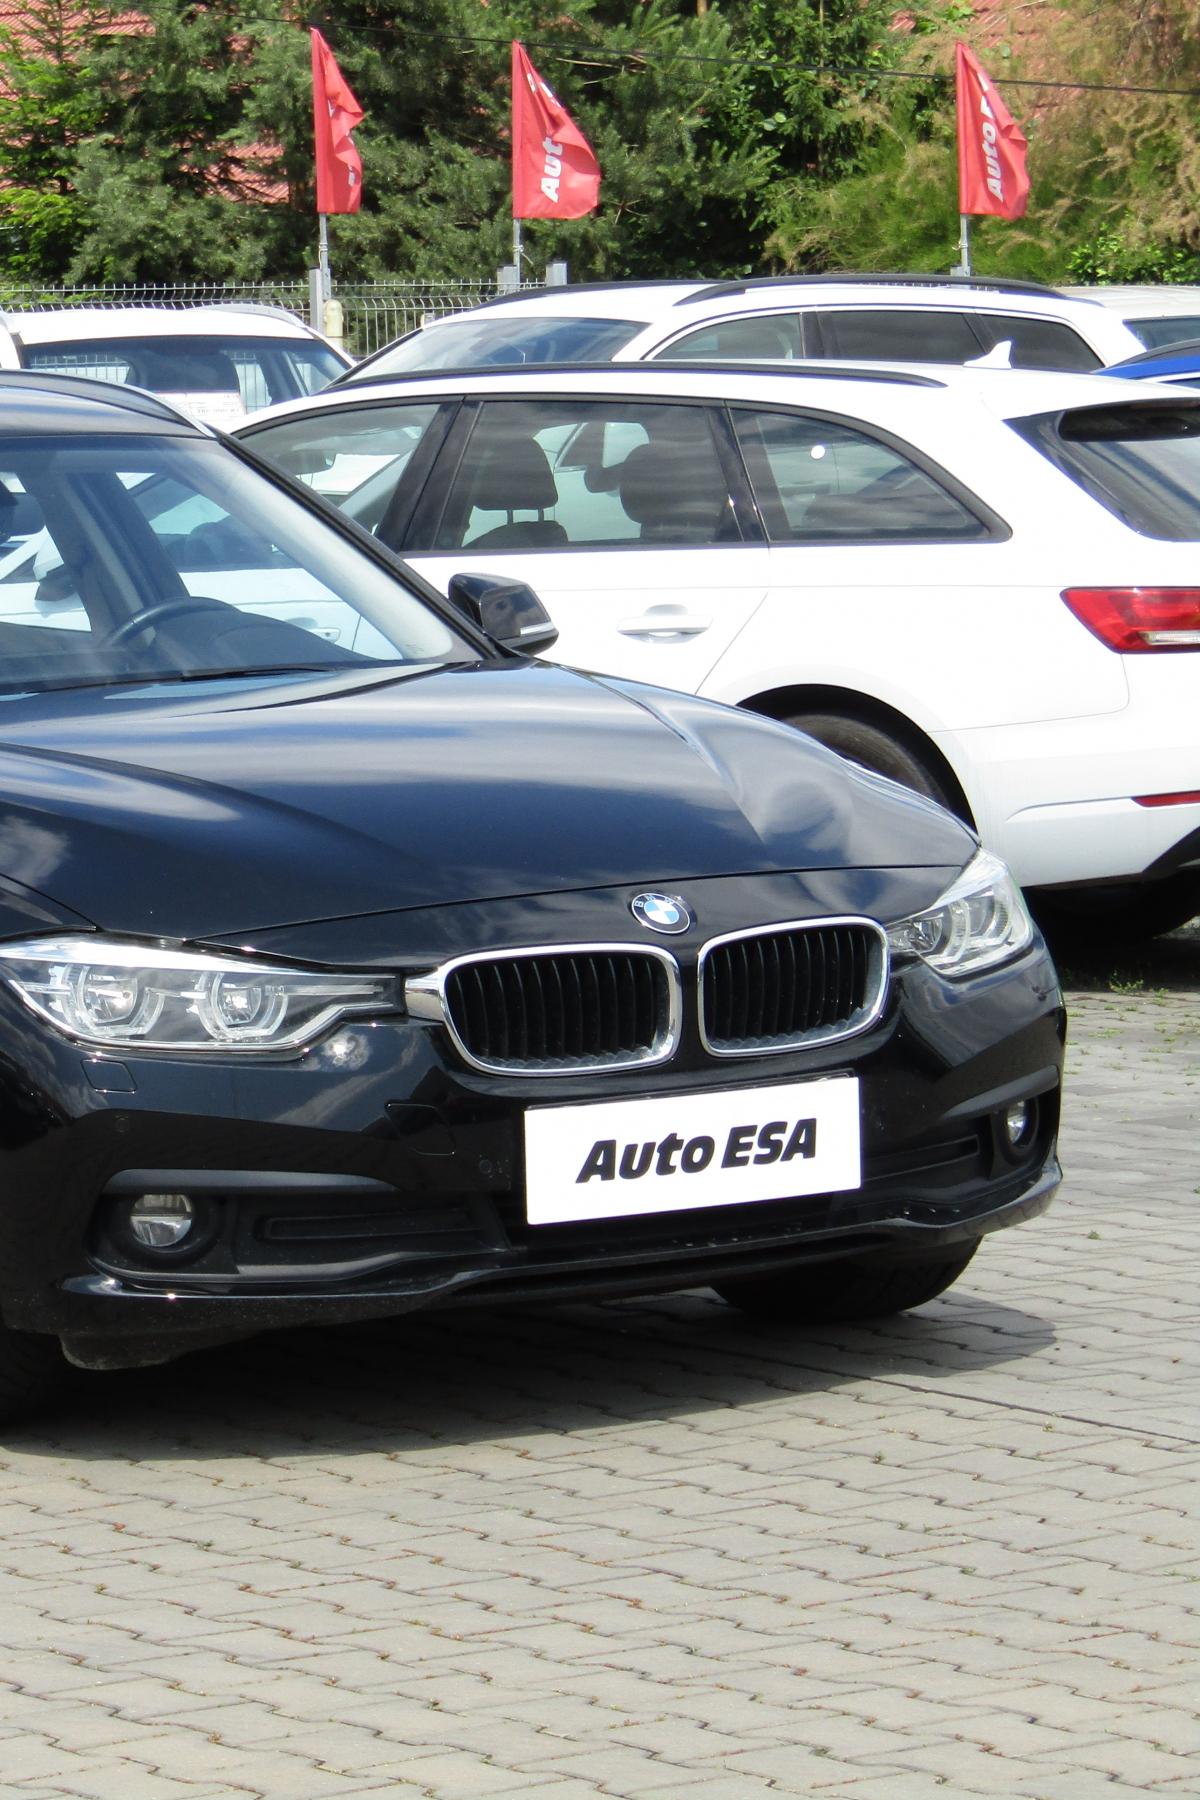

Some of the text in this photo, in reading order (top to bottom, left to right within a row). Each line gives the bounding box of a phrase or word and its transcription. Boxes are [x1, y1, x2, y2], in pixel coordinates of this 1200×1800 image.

[540, 136, 563, 203] Aut
[982, 121, 1004, 203] Auto
[575, 1117, 817, 1184] Auto ESA
